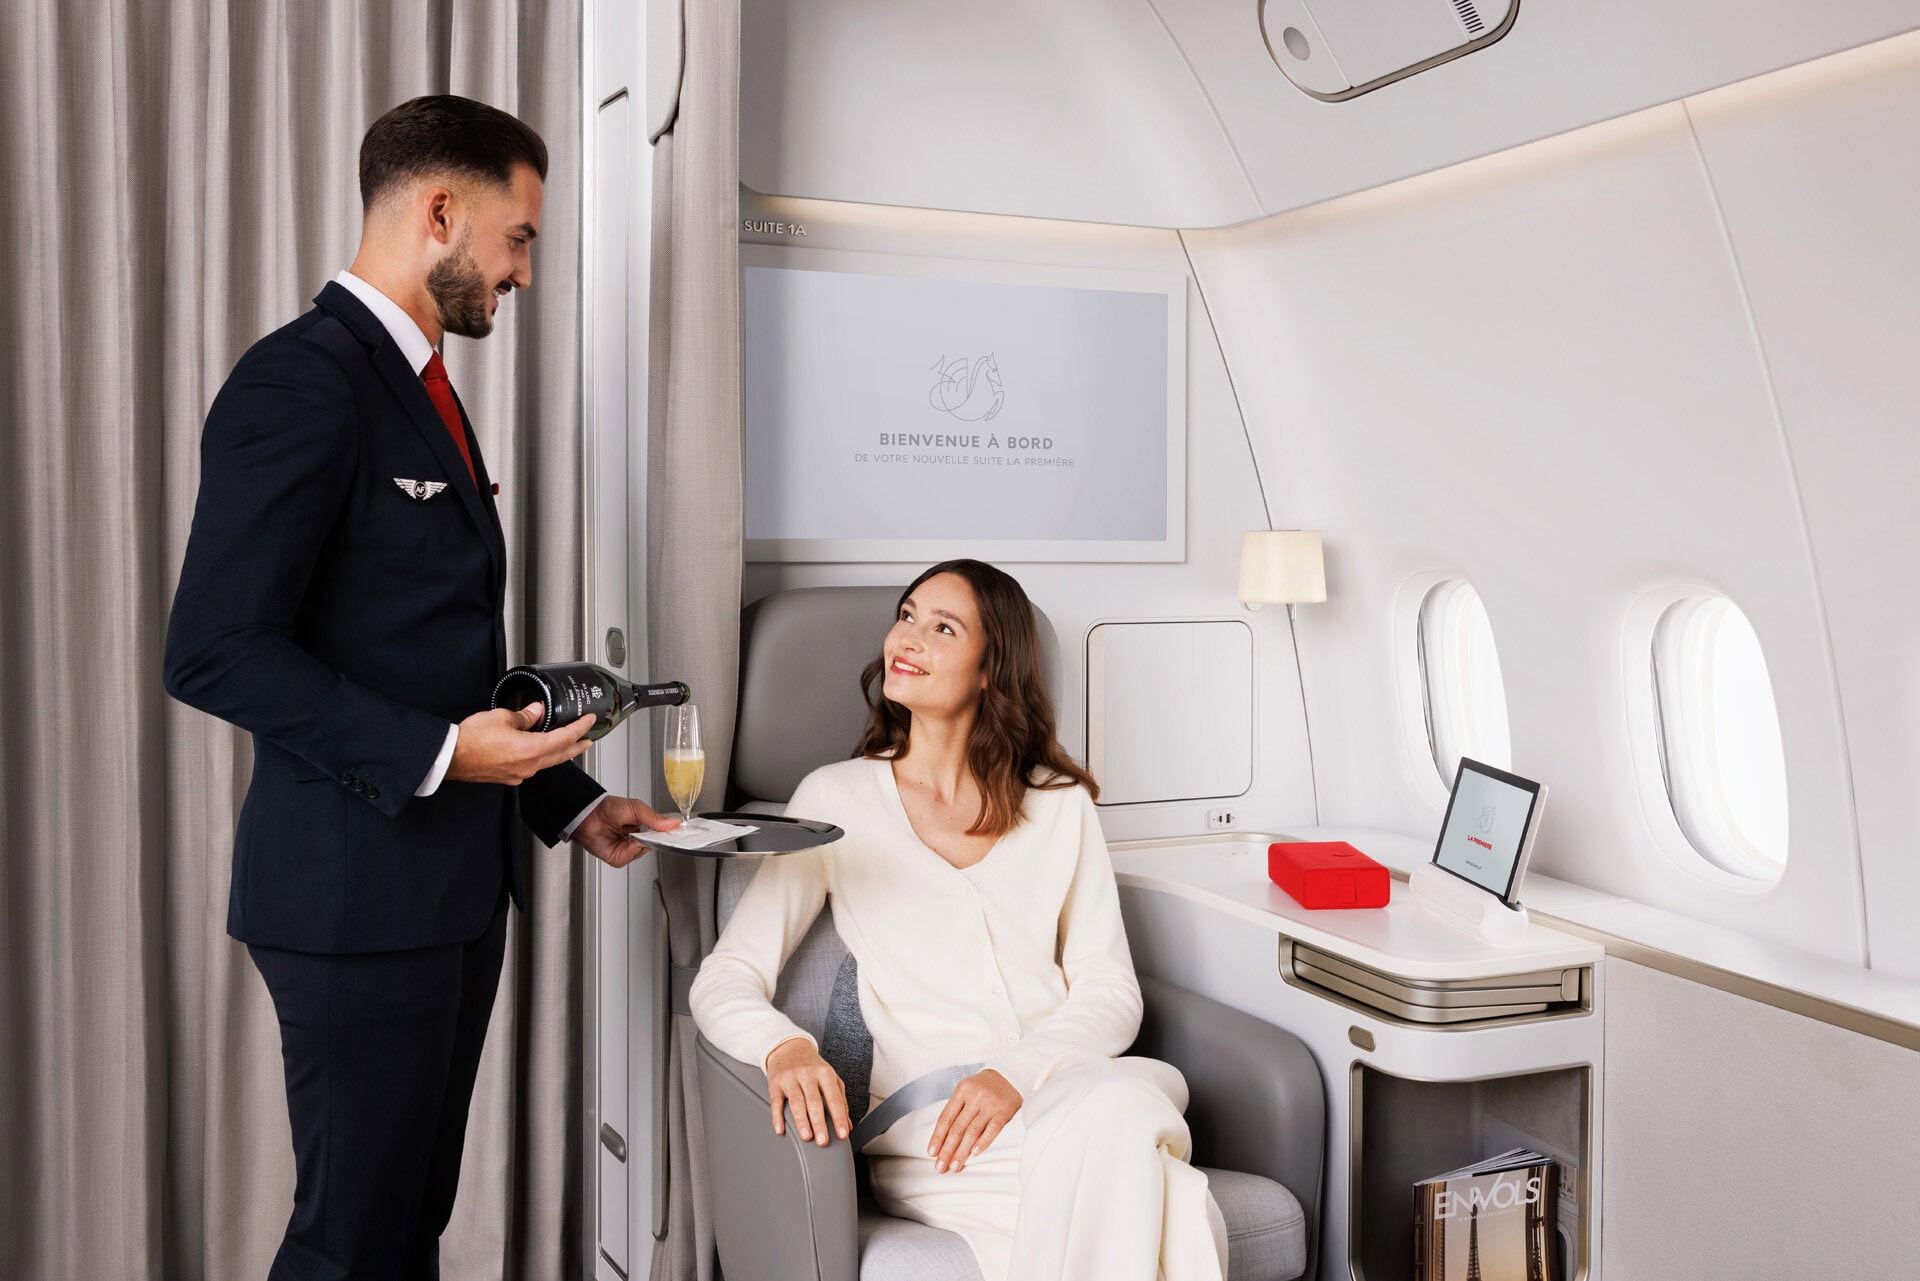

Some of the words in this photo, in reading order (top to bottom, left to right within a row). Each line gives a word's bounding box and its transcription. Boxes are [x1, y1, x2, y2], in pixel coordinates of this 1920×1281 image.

[744, 220, 784, 235] SUITE
[787, 223, 807, 236] 1A
[879, 432, 980, 448] BIENVENUE
[987, 432, 1000, 448] À
[1008, 436, 1053, 450] BORD
[854, 453, 869, 462] DE
[872, 454, 909, 463] VOTRE
[912, 455, 969, 465] NOUVELLE
[973, 456, 1003, 466] SUITE
[1007, 457, 1021, 466] LA
[1024, 456, 1075, 468] PREMIÈRE
[416, 486, 425, 494] AF
[1435, 1173, 1541, 1219] ENVOLS
